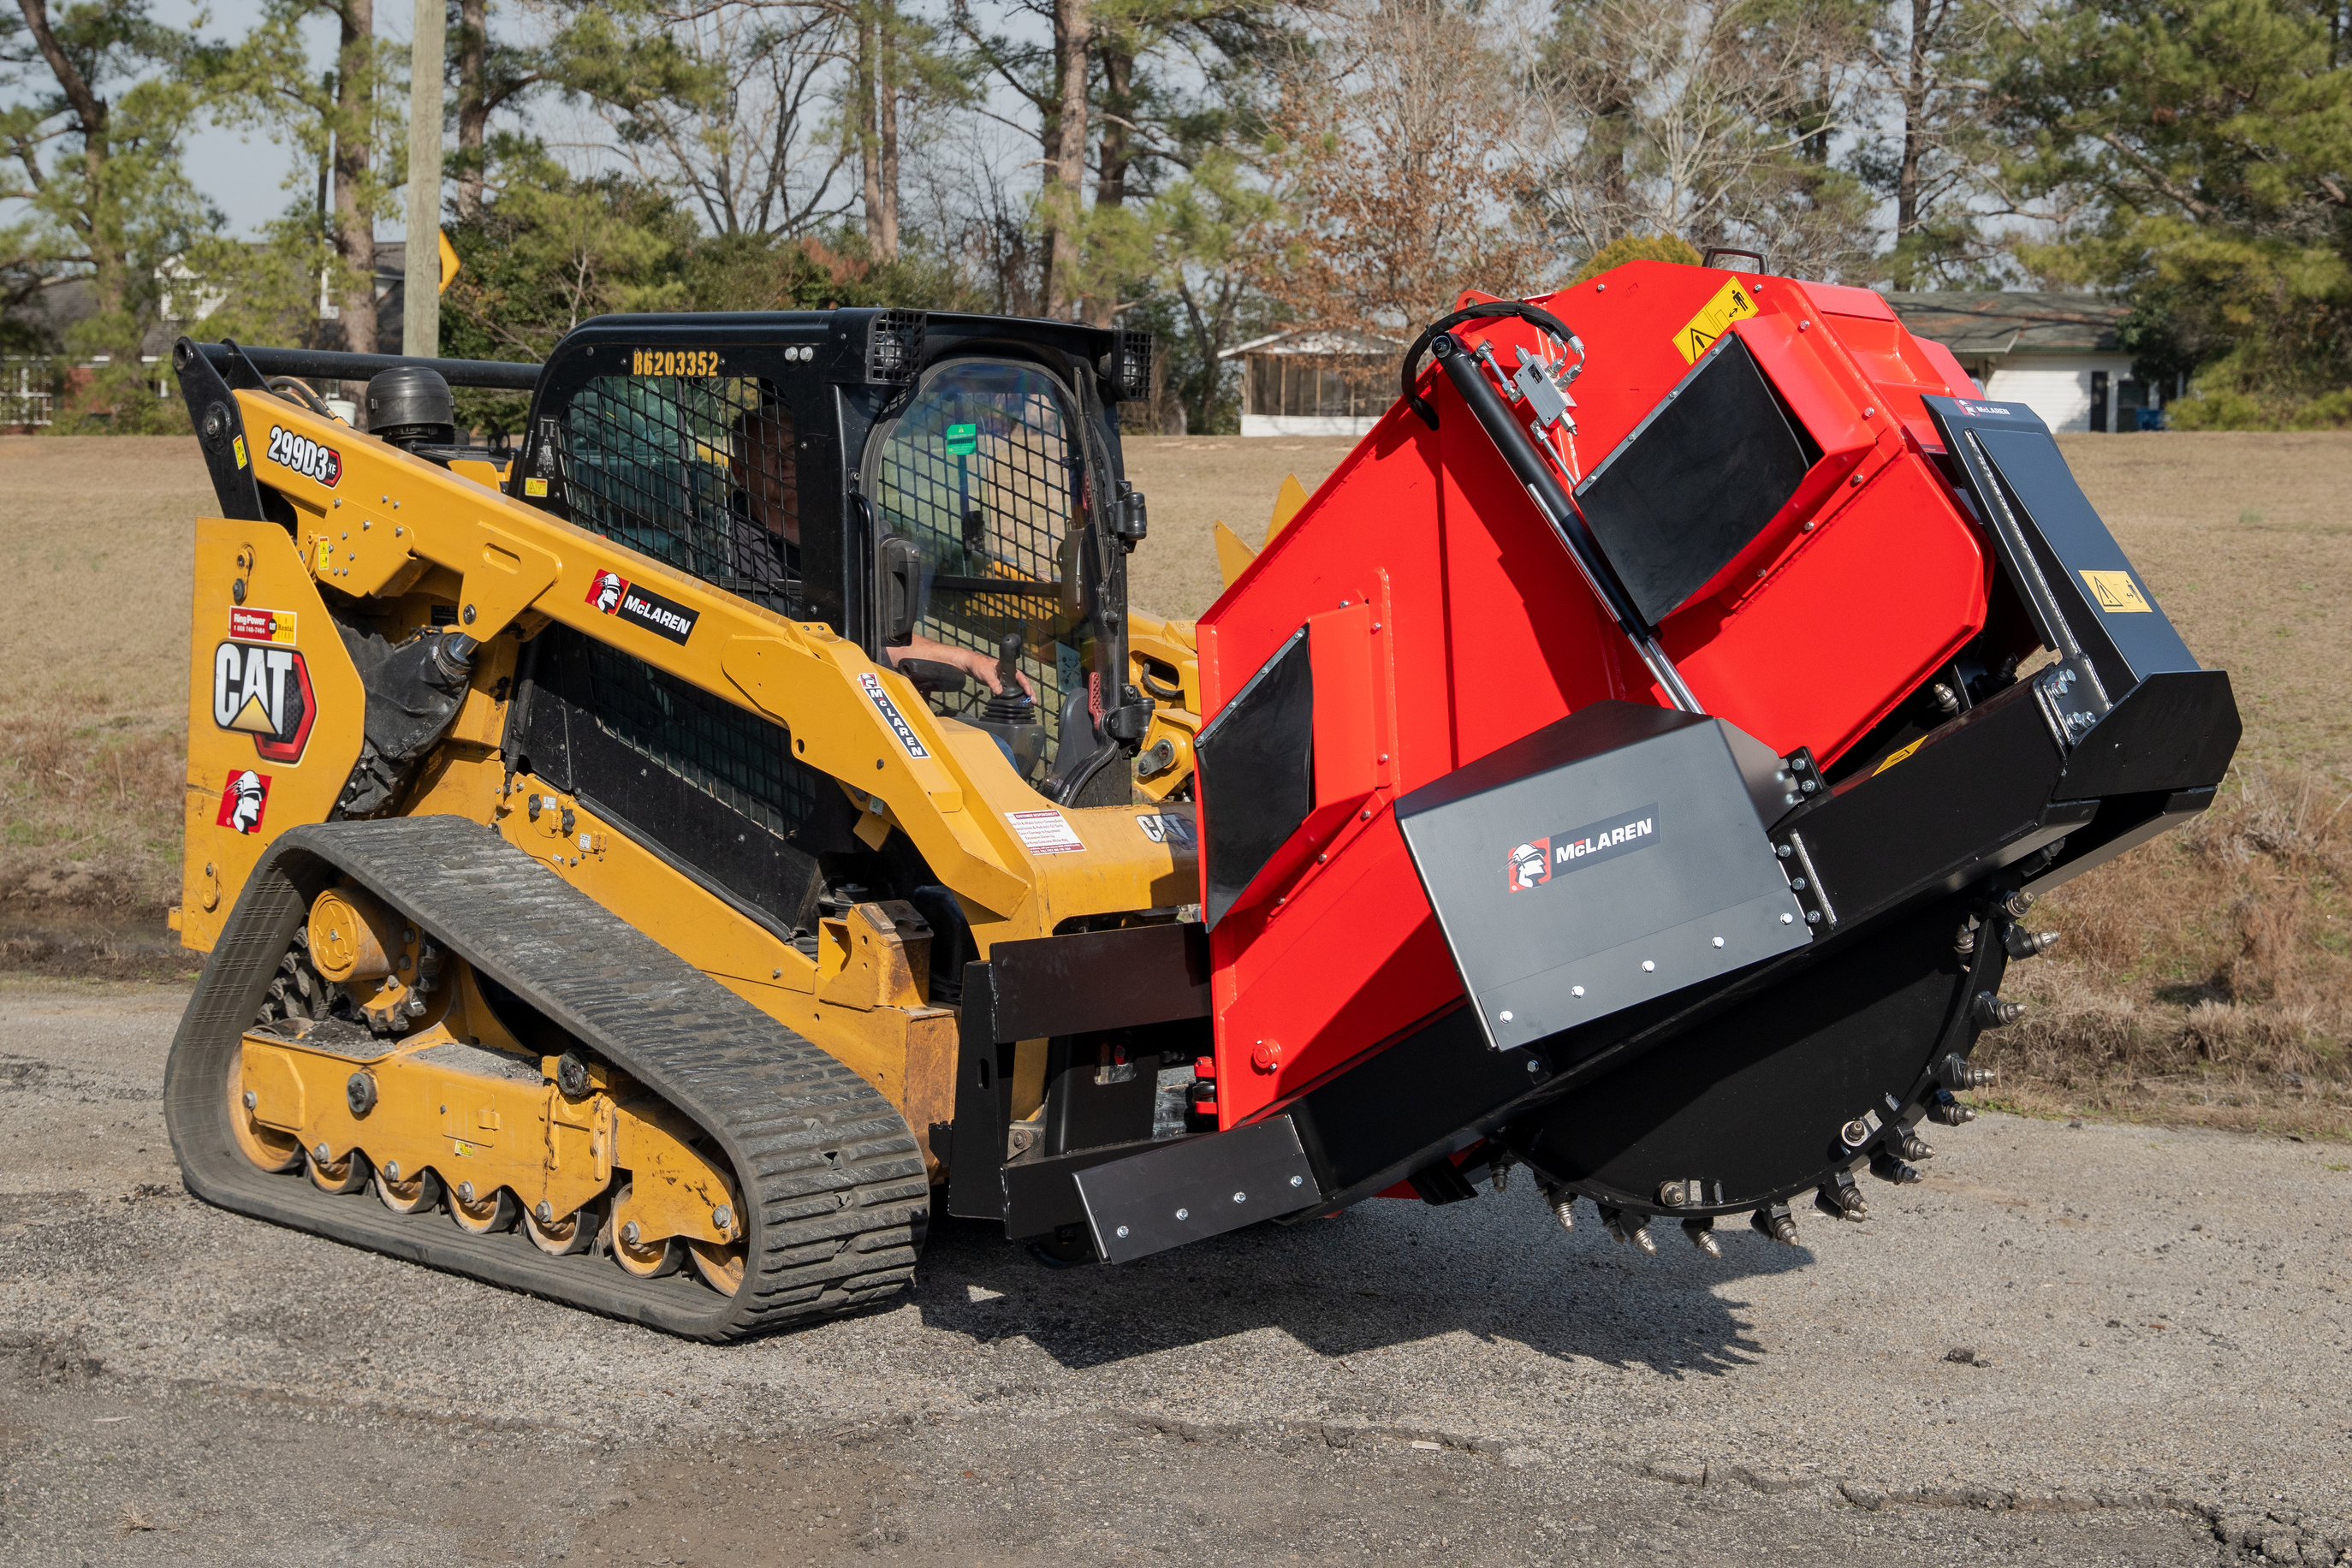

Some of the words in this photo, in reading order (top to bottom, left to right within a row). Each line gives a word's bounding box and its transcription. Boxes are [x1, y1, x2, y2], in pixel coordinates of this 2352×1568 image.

[633, 351, 719, 377] B6203352
[267, 426, 330, 481] 299D3
[327, 462, 337, 475] XE
[234, 613, 246, 626] Ring
[246, 615, 266, 626] Power
[214, 643, 293, 735] CAT
[1136, 813, 1191, 842] CAT
